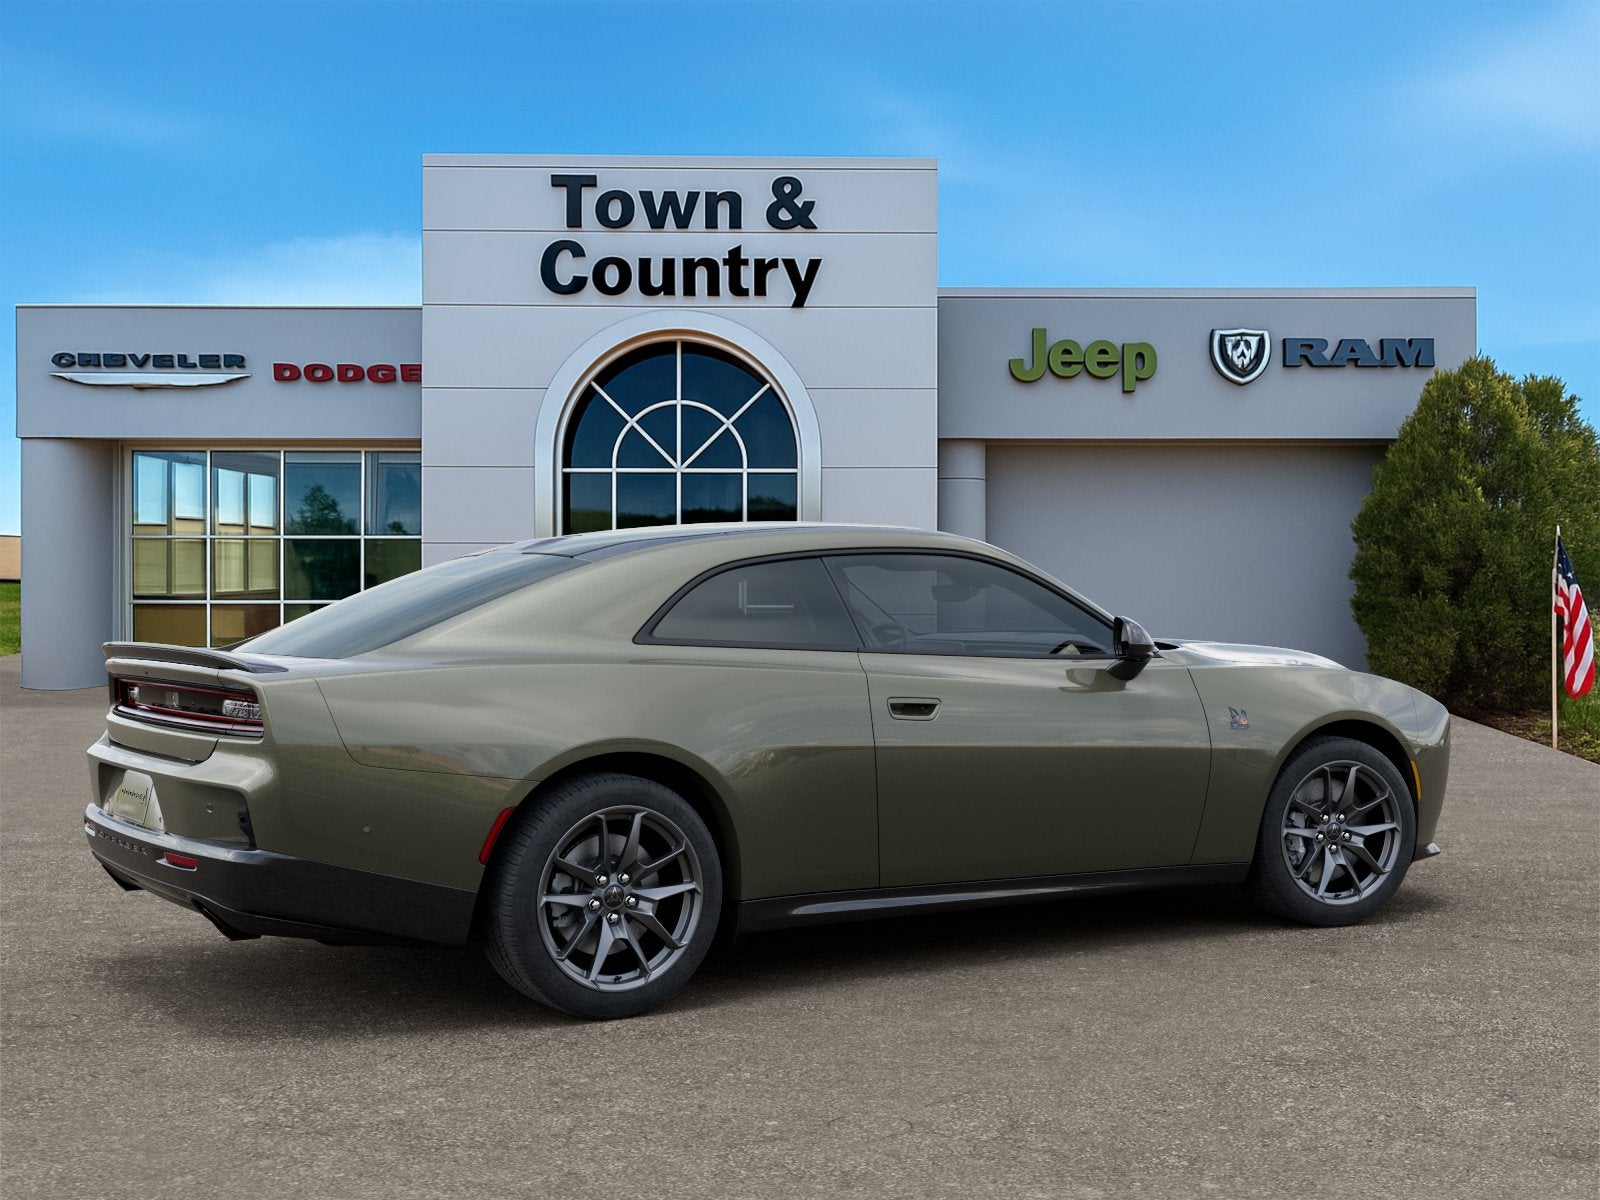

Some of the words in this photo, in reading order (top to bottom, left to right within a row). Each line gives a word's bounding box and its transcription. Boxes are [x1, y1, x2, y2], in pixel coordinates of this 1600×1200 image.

[550, 174, 742, 229] Town
[765, 176, 818, 230] &
[540, 239, 822, 308] Country
[272, 363, 422, 383] DODGE
[1009, 328, 1157, 393] Jeep
[1283, 338, 1435, 368] RAM
